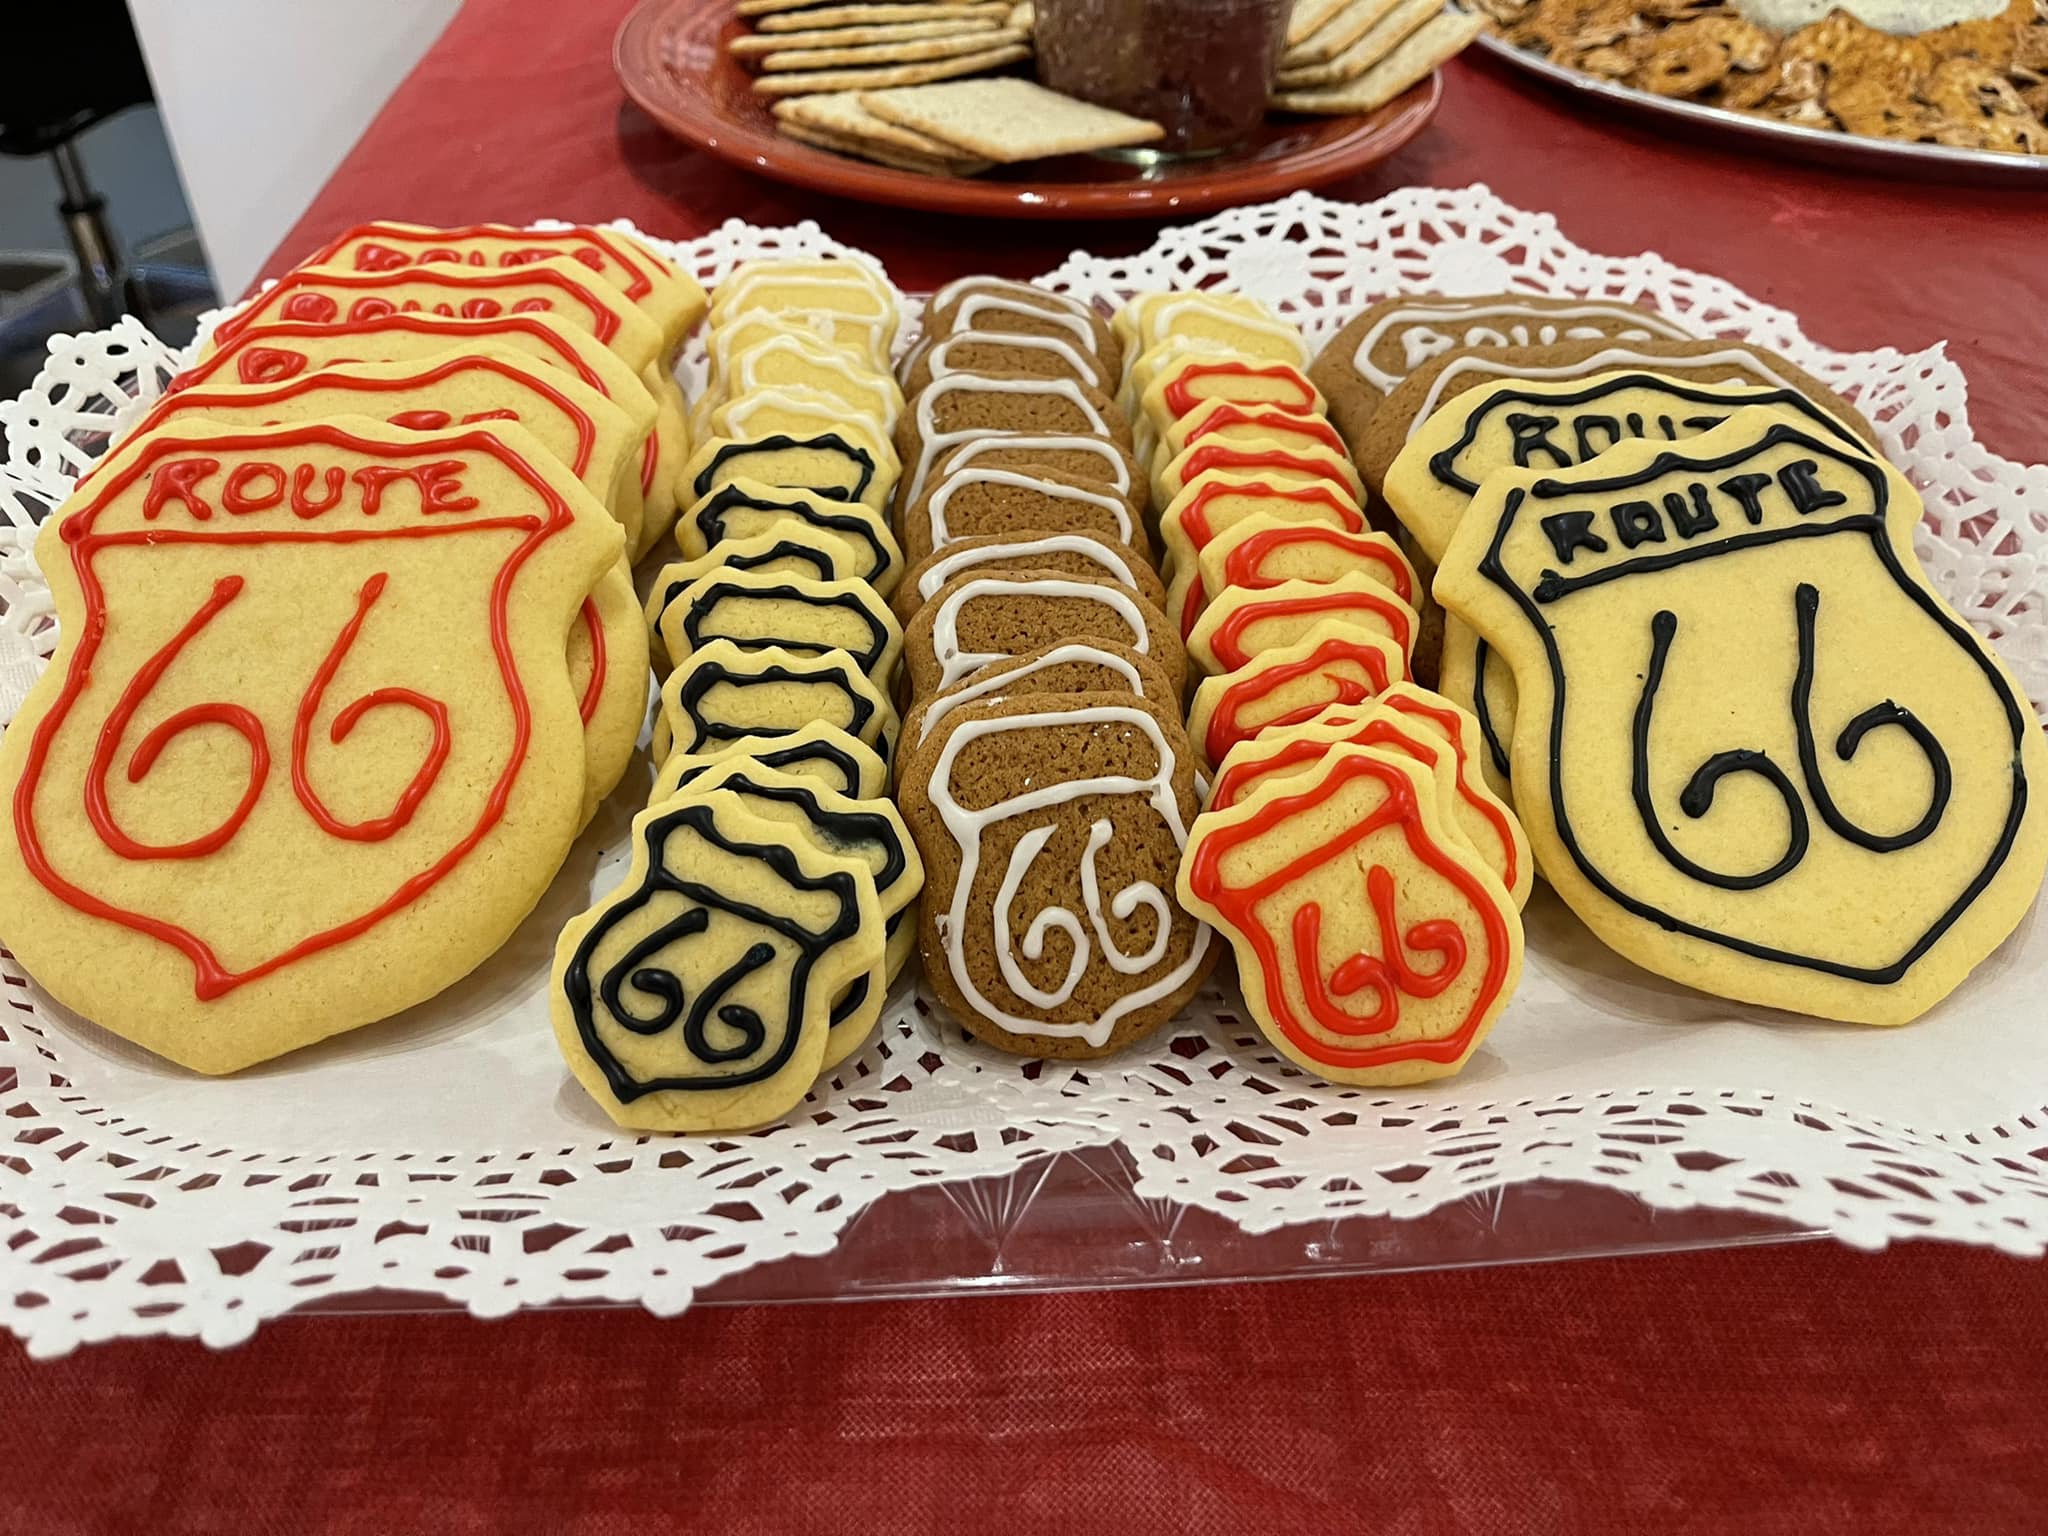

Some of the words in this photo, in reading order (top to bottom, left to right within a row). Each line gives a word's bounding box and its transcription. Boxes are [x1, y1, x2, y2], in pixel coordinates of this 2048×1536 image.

[143, 458, 480, 520] ROUTE
[1540, 459, 1847, 564] ROUTE
[84, 573, 451, 861] 66
[1632, 582, 1952, 891] 66
[600, 906, 777, 1064] 66
[993, 818, 1172, 1010] 66
[1292, 863, 1467, 1036] 66
